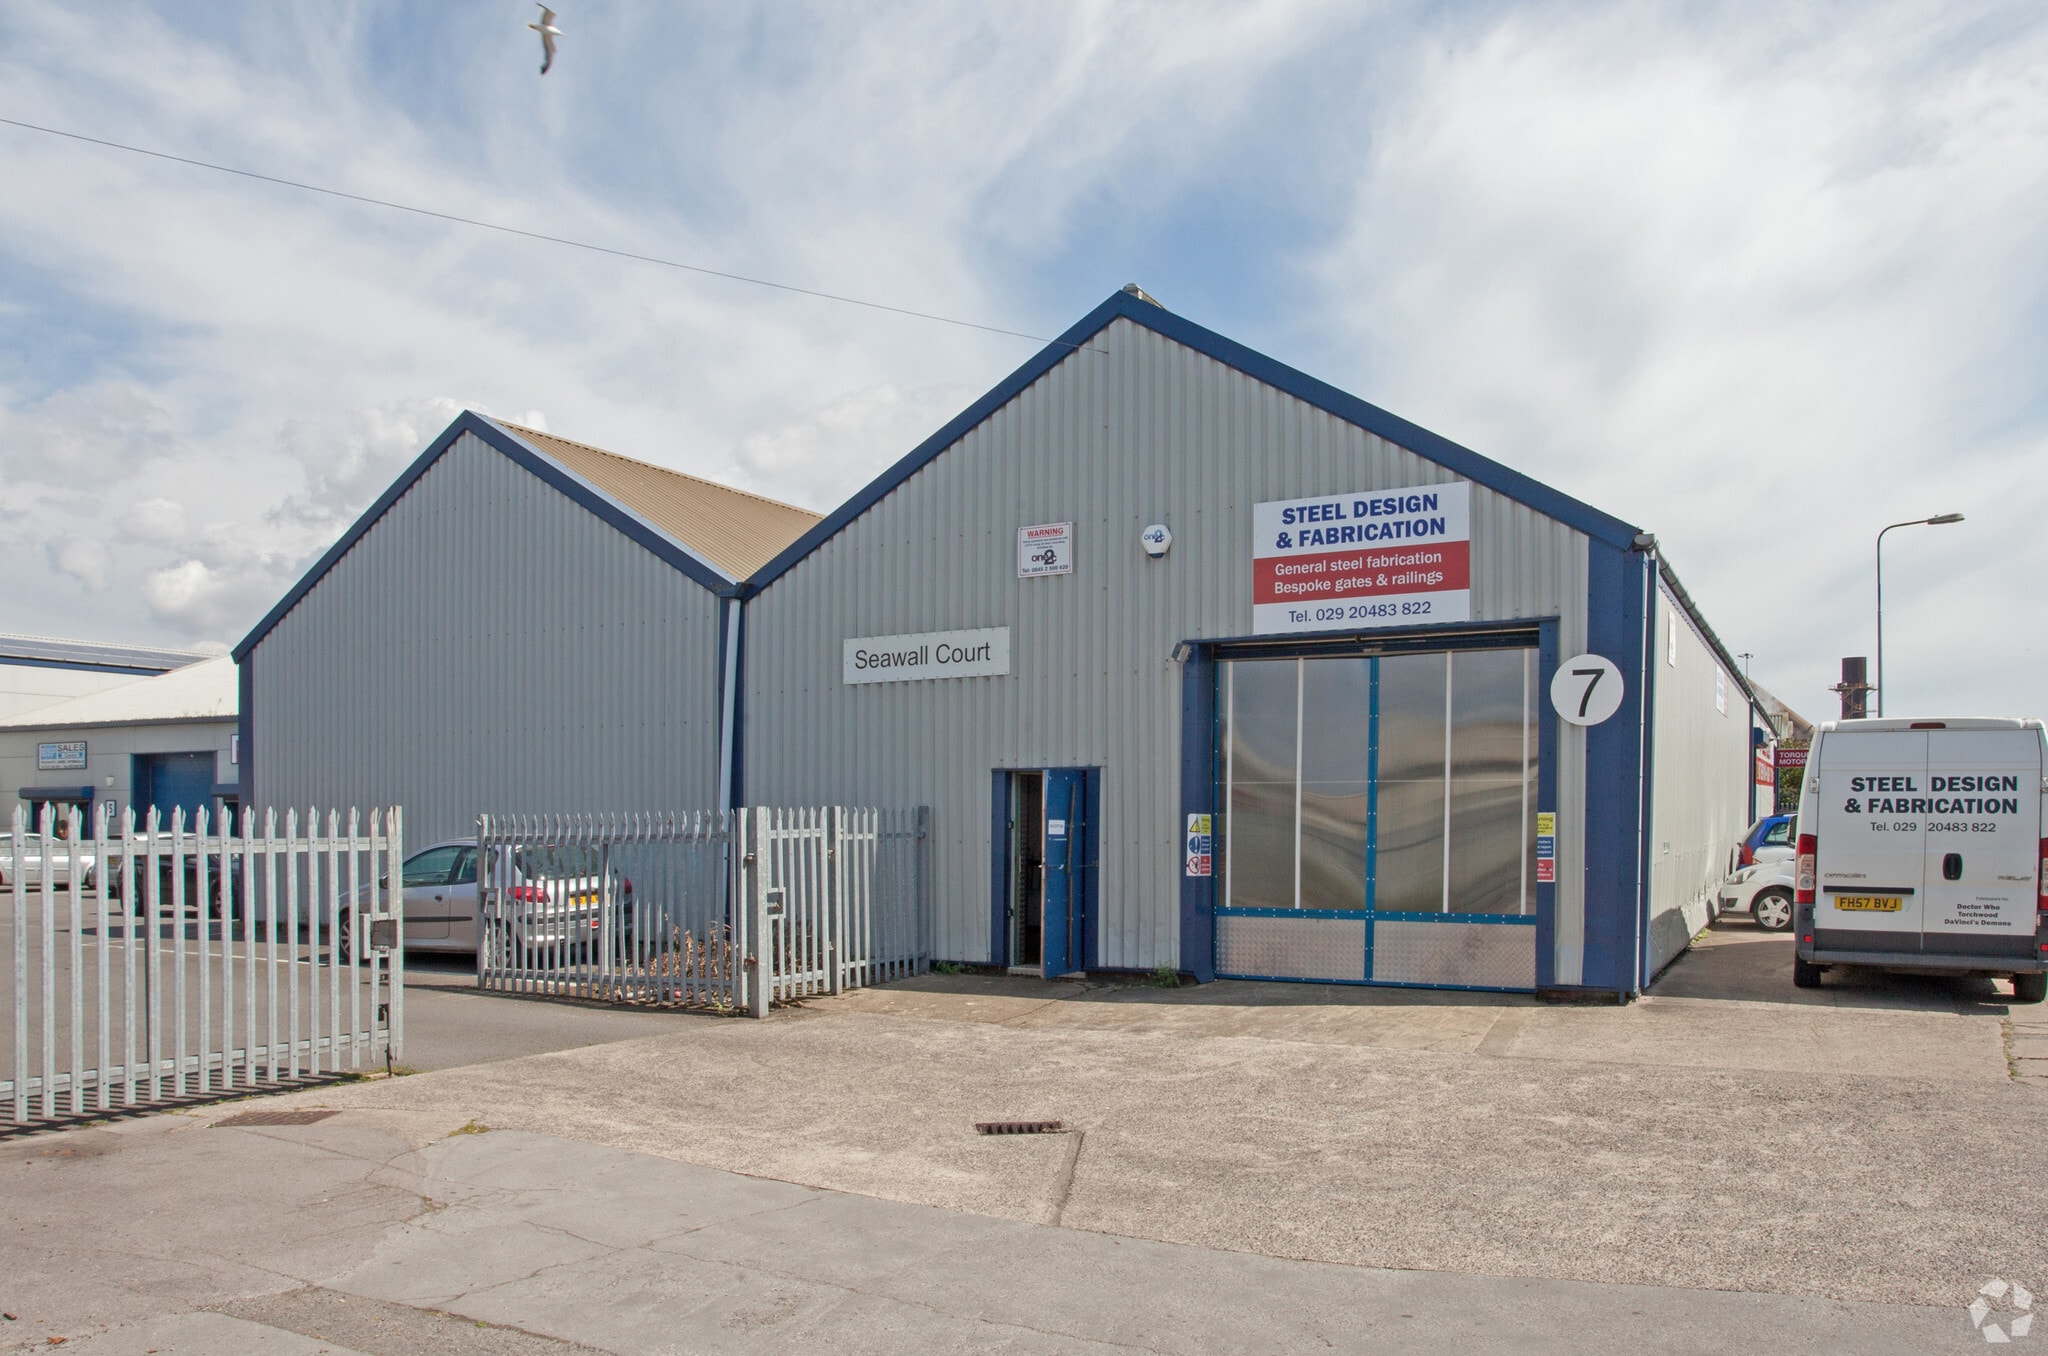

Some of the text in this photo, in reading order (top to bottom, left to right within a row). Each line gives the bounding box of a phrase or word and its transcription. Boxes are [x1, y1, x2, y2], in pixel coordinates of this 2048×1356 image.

[1282, 493, 1439, 525] STEEL DESIGN
[1026, 527, 1064, 537] WARNING
[1275, 517, 1445, 549] & FABRICATION
[1274, 551, 1442, 576] General steel fabrication
[1274, 570, 1443, 595] Bespoke gates & railings
[1288, 601, 1431, 623] Tel. 029 20483 822
[854, 641, 991, 670] Seawall Court
[1572, 669, 1605, 717] 7
[57, 744, 84, 752] SALES
[1851, 775, 2018, 792] STEEL DESIGN
[109, 804, 113, 814] 5
[1844, 798, 2018, 814] & FABRICATION
[1870, 822, 1996, 833] Tel. 029 20483 822
[1840, 897, 1897, 909] FH57 BVJ
